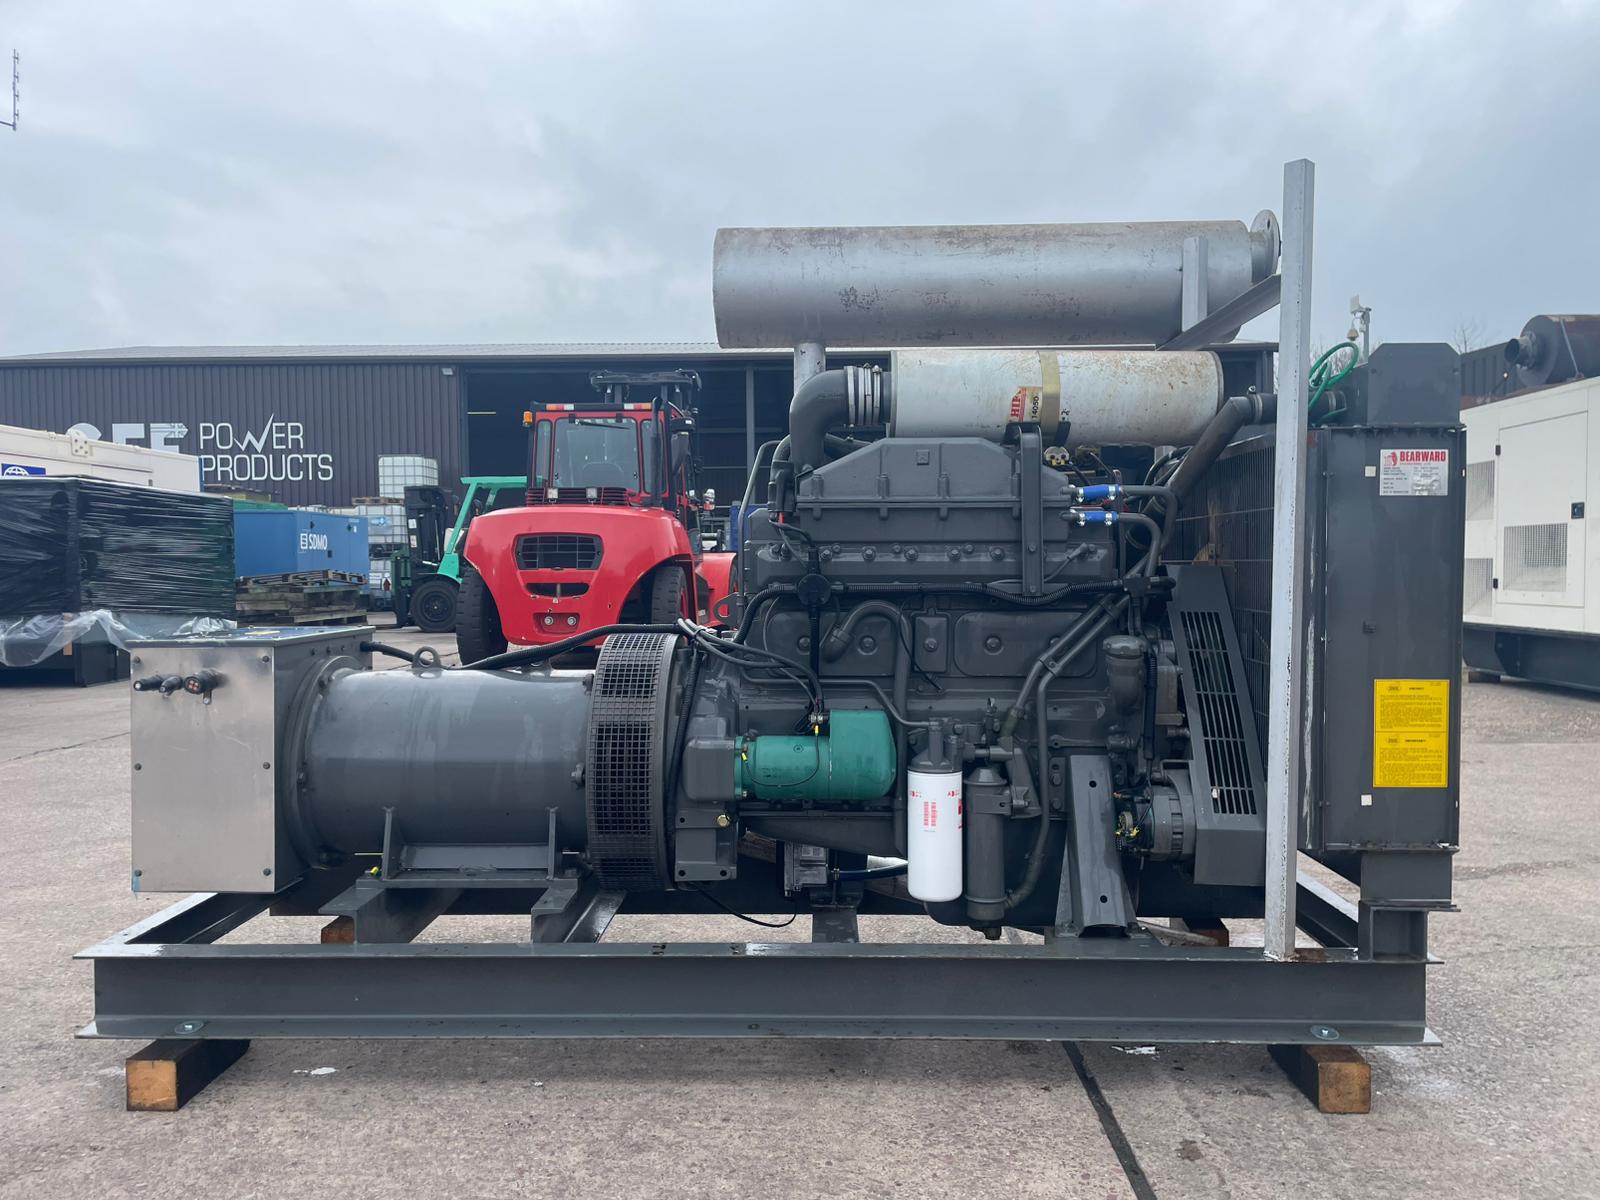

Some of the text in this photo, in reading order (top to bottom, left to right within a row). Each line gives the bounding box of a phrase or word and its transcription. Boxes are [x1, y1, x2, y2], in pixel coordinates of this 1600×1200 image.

[199, 412, 304, 453] POWER
[202, 454, 333, 481] PRODUCTS
[1400, 451, 1446, 462] BEARWARD
[308, 533, 328, 550] SDMO
